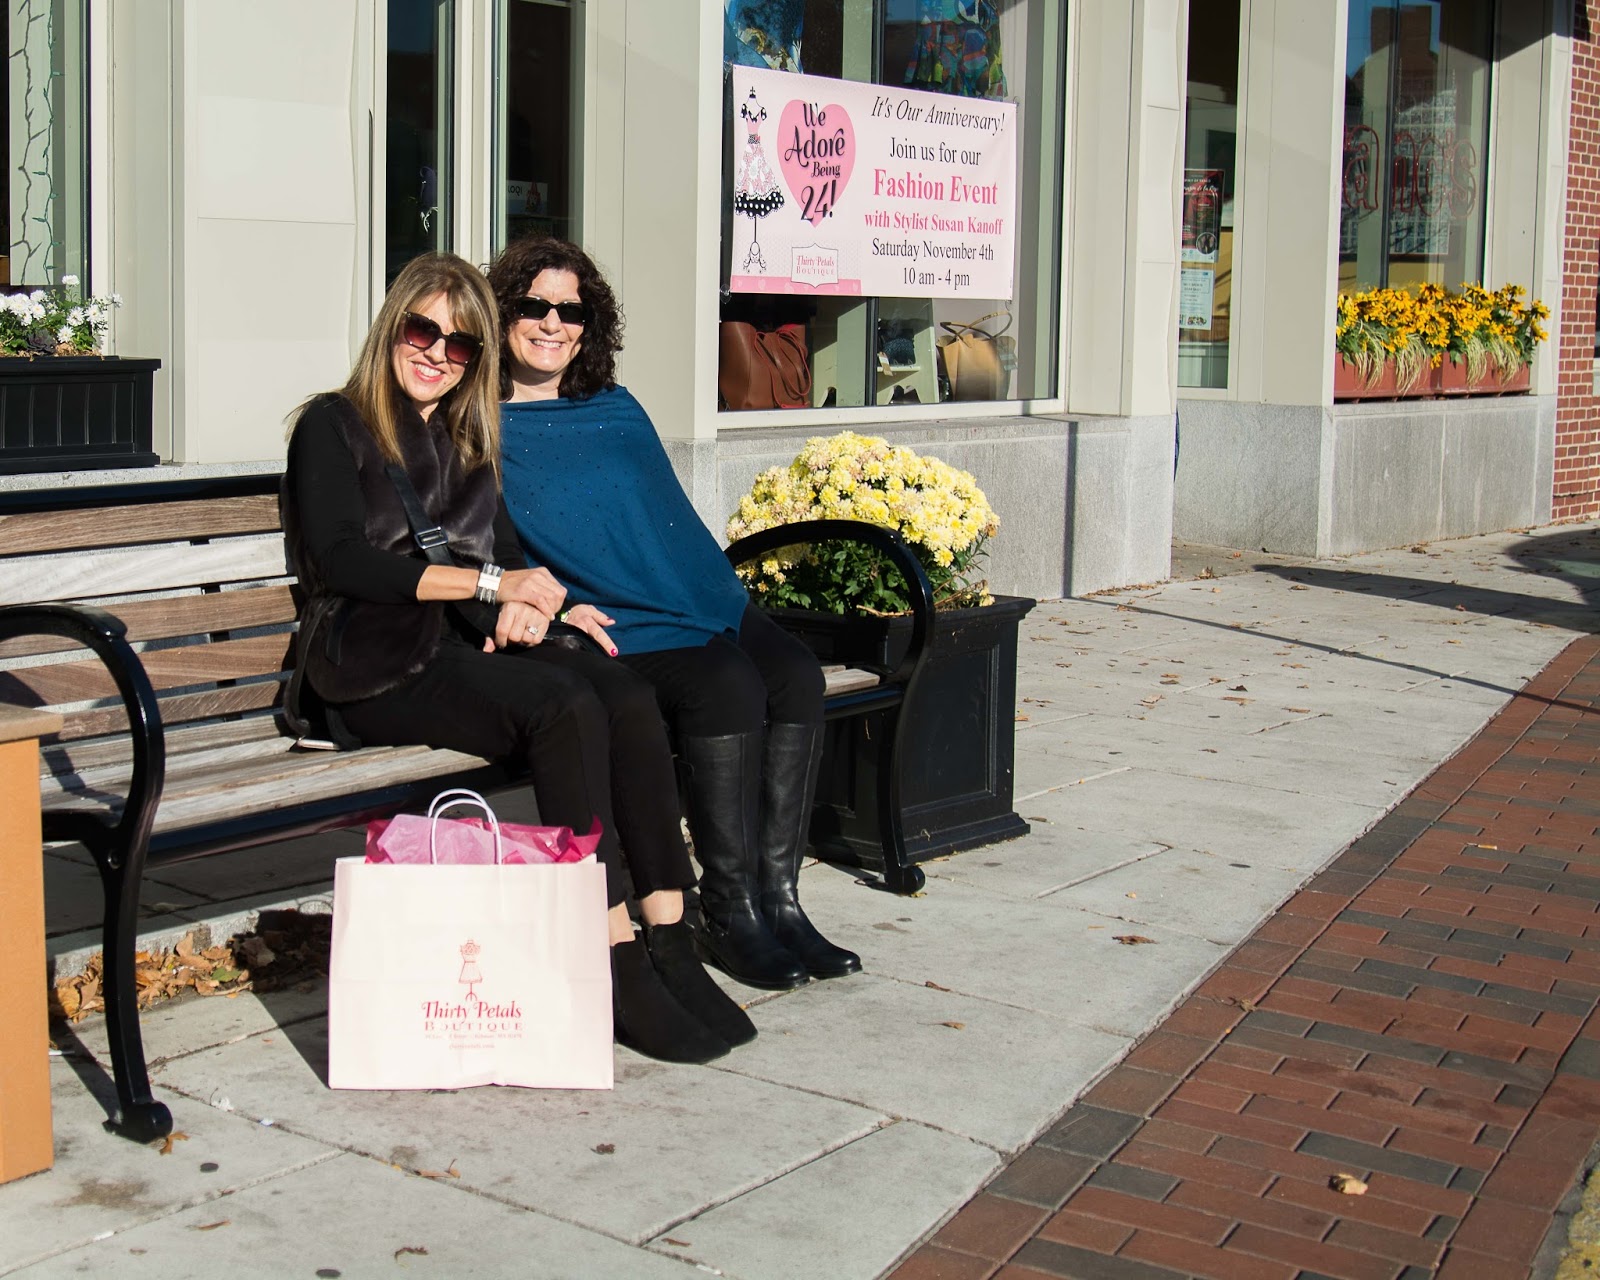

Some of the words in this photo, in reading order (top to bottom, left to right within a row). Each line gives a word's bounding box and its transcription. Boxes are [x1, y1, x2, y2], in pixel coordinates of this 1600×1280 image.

[803, 102, 826, 127] We
[872, 96, 893, 117] It's
[896, 99, 923, 121] Our
[925, 103, 1005, 136] Anniversary!
[784, 125, 845, 167] Adore
[889, 137, 917, 160] Join
[920, 146, 935, 162] us
[938, 142, 957, 163] for
[960, 150, 982, 166] our
[811, 161, 841, 178] Being
[873, 168, 944, 201] Fashion
[949, 175, 998, 205] Event
[800, 179, 837, 222] 24!
[864, 210, 890, 228] with
[893, 211, 929, 235] Stylist
[930, 215, 964, 233] Susan
[967, 217, 1004, 236] Kanoff
[796, 255, 814, 266] Thirty
[816, 256, 834, 266] Petals
[872, 238, 920, 261] Saturday
[923, 240, 977, 260] November
[978, 243, 994, 260] 4th
[903, 267, 916, 284] 10
[918, 273, 935, 285] am
[944, 268, 952, 286] 4
[954, 275, 970, 290] pm
[421, 1000, 470, 1024] Thirty
[473, 1000, 522, 1019] Petals
[425, 1021, 523, 1032] BOUTIQUE
